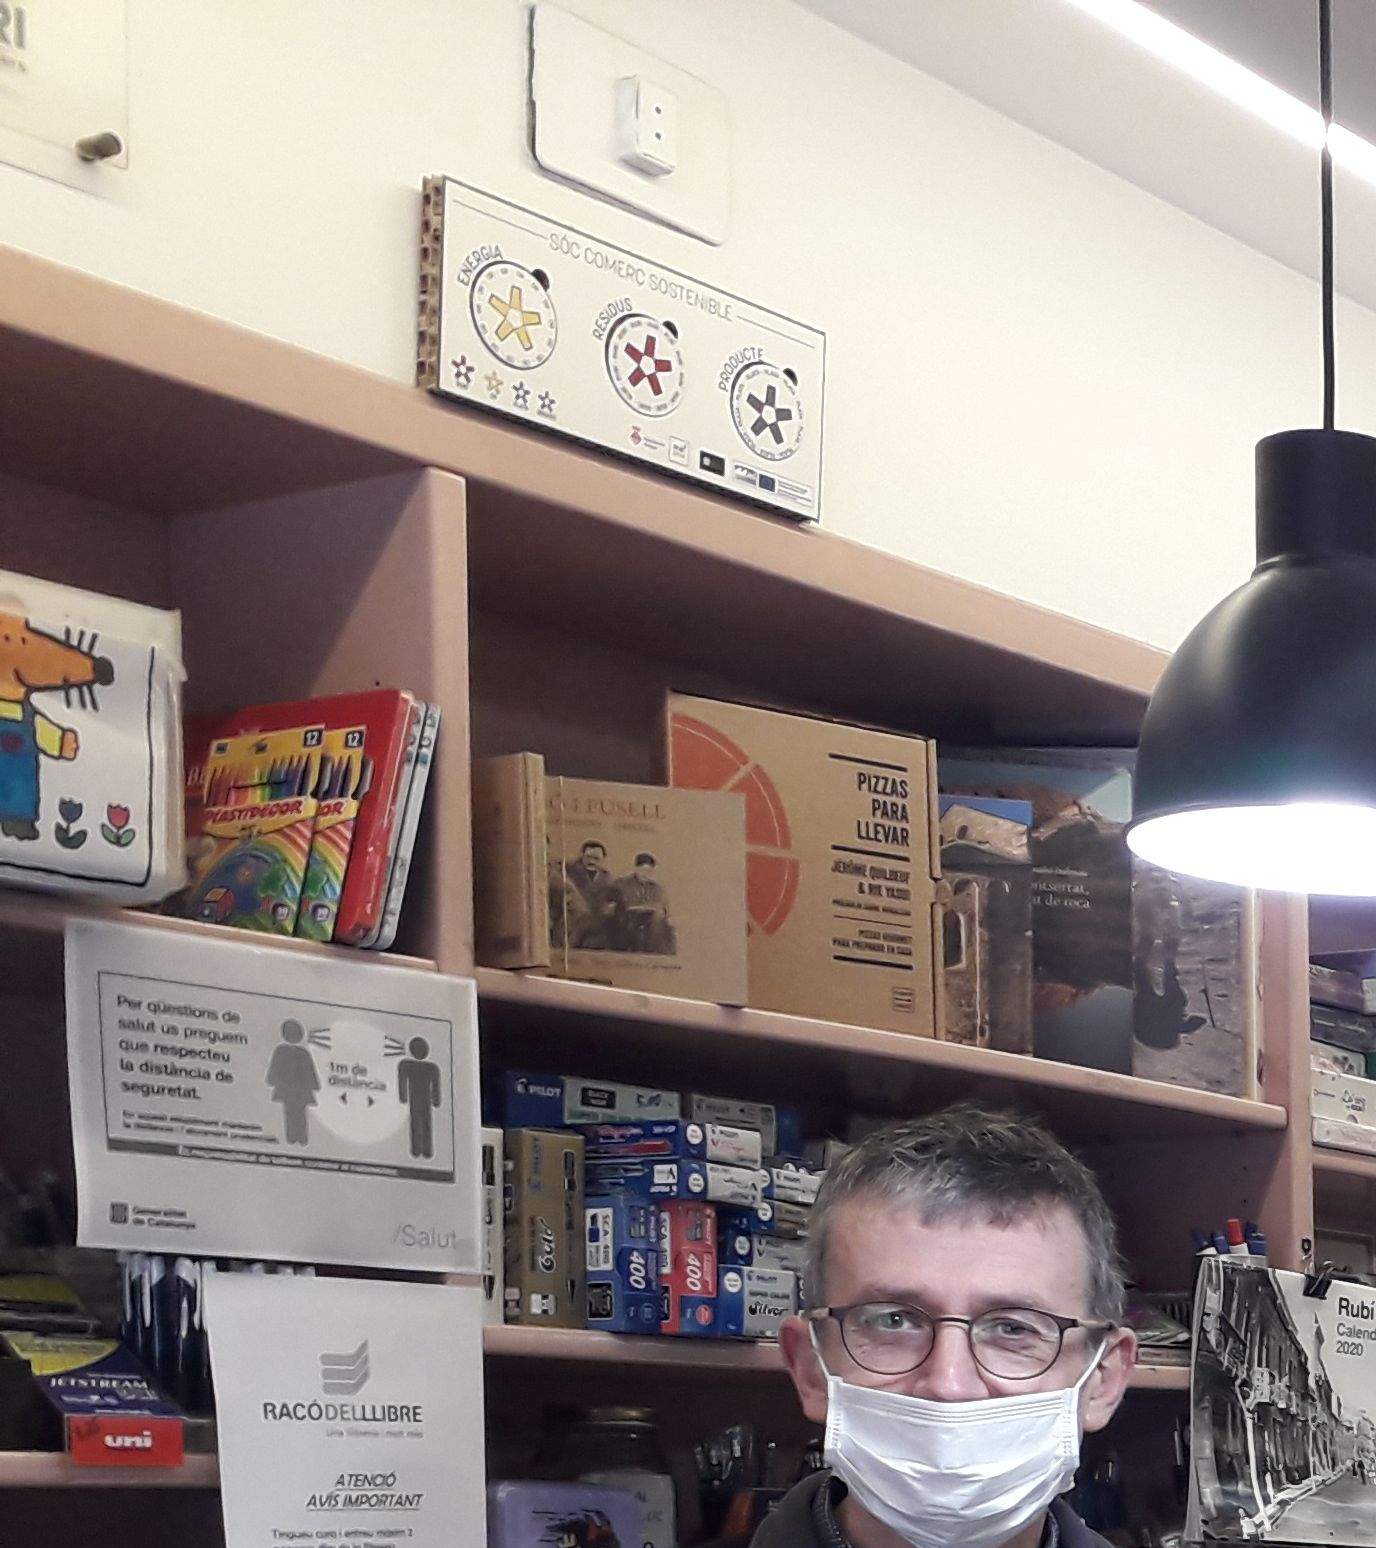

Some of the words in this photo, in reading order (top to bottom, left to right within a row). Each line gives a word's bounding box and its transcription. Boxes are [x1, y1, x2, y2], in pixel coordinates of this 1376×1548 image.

[457, 244, 504, 287] ENERGIA
[550, 233, 580, 259] SÓC
[584, 247, 646, 287] COMERC
[650, 273, 733, 322] SOSTENIBLE
[592, 297, 634, 340] RESIDUS
[857, 771, 909, 800] PIZZAS
[871, 799, 910, 825] PARA
[856, 819, 910, 848] LLEVAR
[116, 994, 143, 1011] Per
[147, 1000, 219, 1021] qüestions
[222, 1010, 241, 1023] de
[118, 1018, 156, 1034] salut
[160, 1024, 179, 1036] us
[183, 1027, 249, 1045] preguem
[118, 1039, 150, 1053] que
[153, 1043, 231, 1063] respecteu
[119, 1057, 134, 1072] la
[139, 1061, 212, 1081] distància
[215, 1069, 234, 1084] de
[351, 1063, 368, 1076] de
[529, 1085, 562, 1098] PILOT
[629, 1250, 646, 1289] 400
[686, 1252, 702, 1291] 400
[1338, 1296, 1376, 1320] Rubí
[1336, 1341, 1364, 1356] 2020
[50, 1376, 149, 1389] JETSTREAM
[103, 1431, 153, 1449] uni
[335, 1471, 397, 1489] ATENCIÓ
[342, 1493, 424, 1509] IMPORTANT
